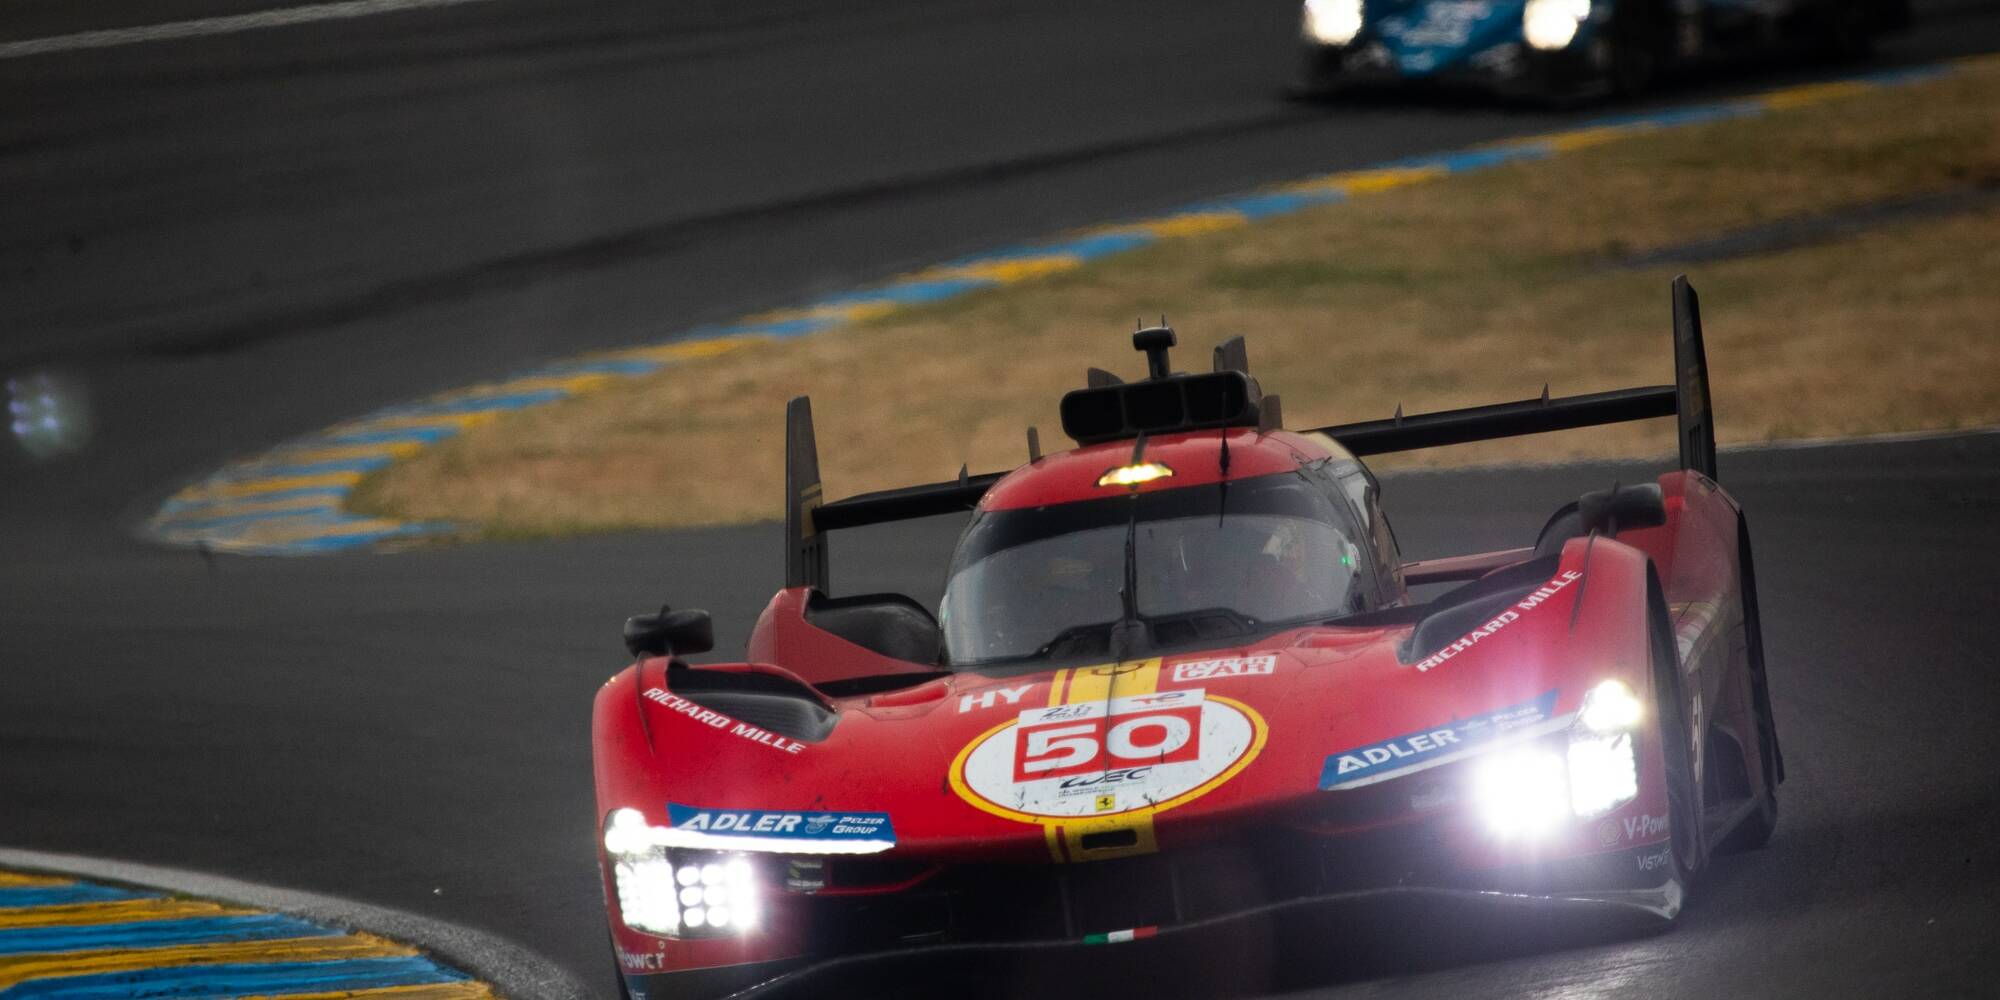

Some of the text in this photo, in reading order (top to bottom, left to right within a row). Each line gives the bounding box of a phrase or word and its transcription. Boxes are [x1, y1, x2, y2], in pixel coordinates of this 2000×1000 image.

[1416, 570, 1583, 672] RICHARD MILLE
[1180, 662, 1268, 679] CAR
[959, 684, 1034, 713] HY
[642, 687, 806, 754] RICHARD MILLE
[1024, 715, 1191, 774] 50
[1337, 729, 1461, 775] ADLER
[1060, 766, 1152, 789] WEC
[677, 813, 802, 832] ADLER
[832, 824, 878, 834] GROUP
